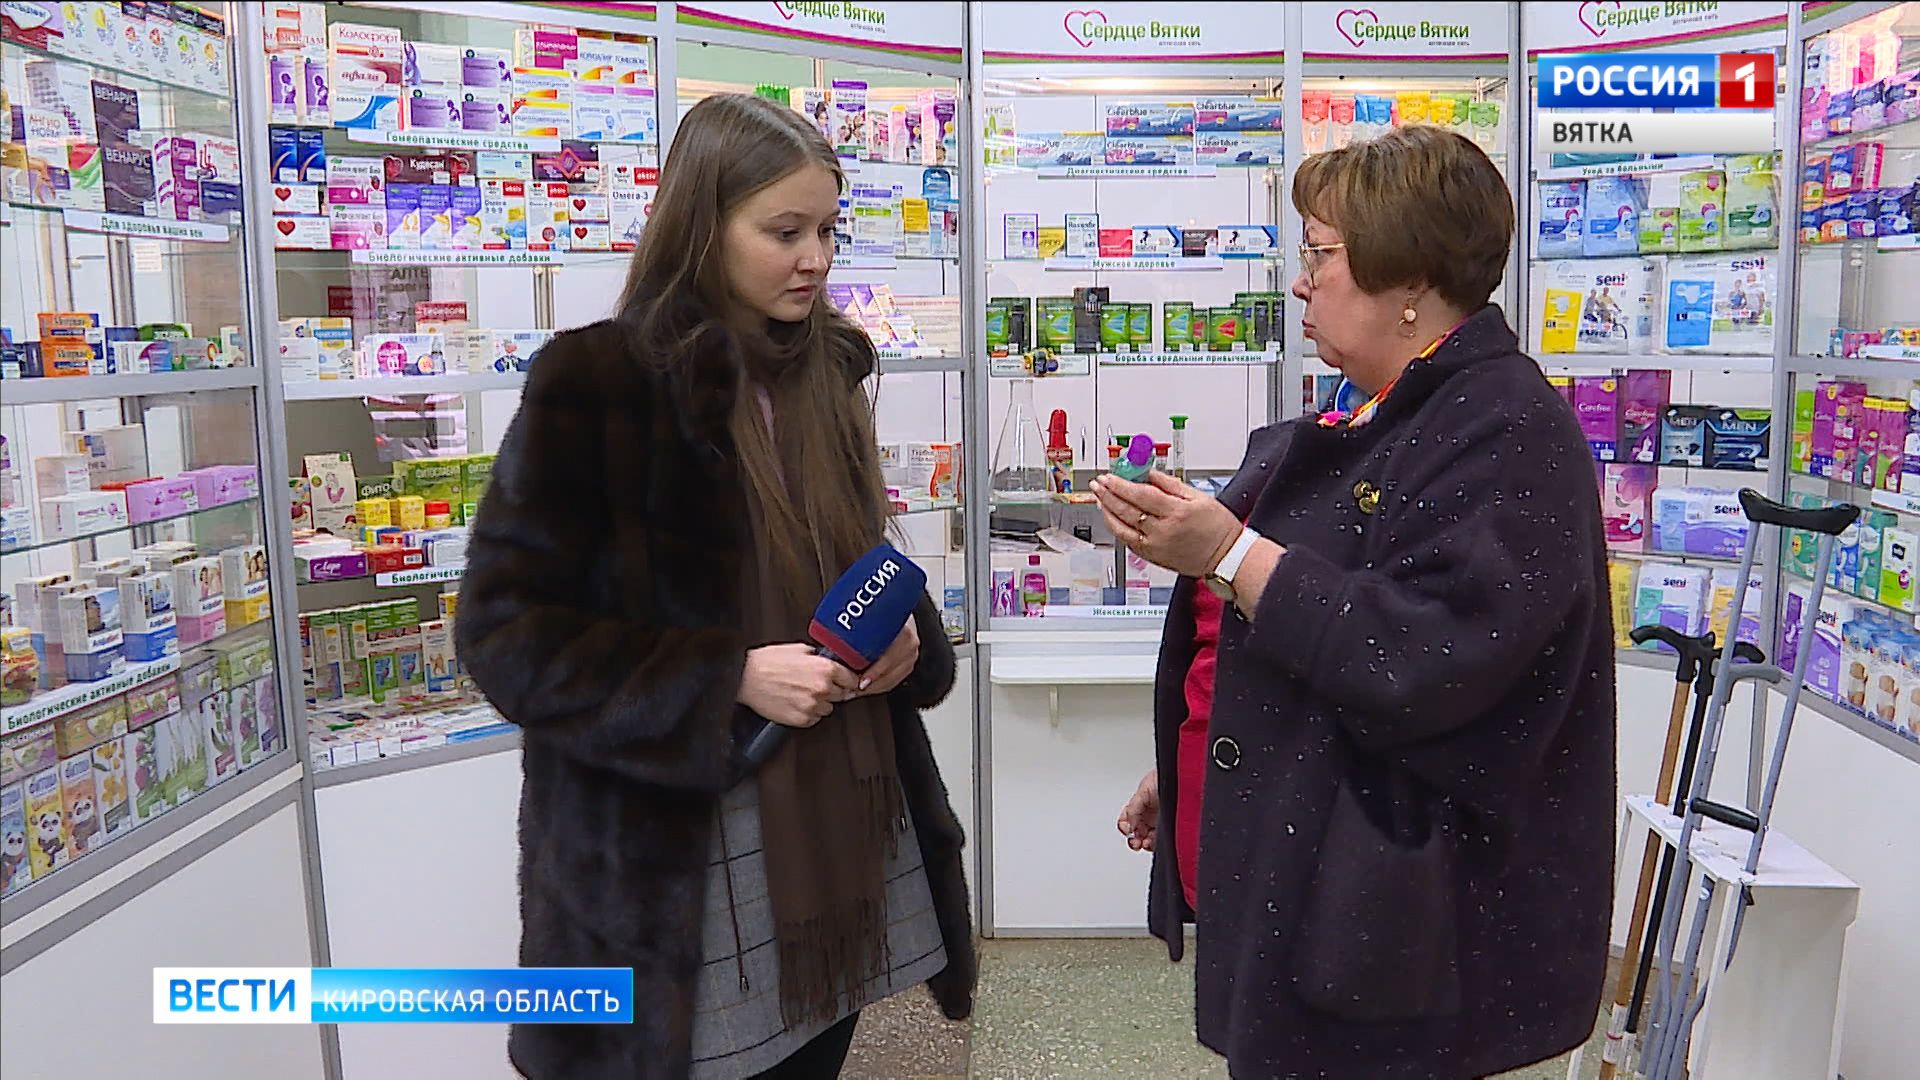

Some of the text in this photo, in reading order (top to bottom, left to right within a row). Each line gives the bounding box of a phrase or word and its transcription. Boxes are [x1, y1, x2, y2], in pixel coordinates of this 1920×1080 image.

[843, 3, 885, 25] Вятки
[1596, 4, 1660, 28] Сердце
[339, 27, 399, 44] Колофорт
[1083, 20, 1200, 41] Сердце Вятки
[1354, 20, 1469, 41] Сердце Вятки
[1106, 105, 1148, 117] Clearblue
[1196, 100, 1236, 111] Clearblue
[386, 132, 529, 150] Гомеопатические средства
[1106, 138, 1144, 149] Clearblue
[1198, 137, 1239, 147] Clearblue
[1066, 167, 1189, 177] Диагностические средства
[1582, 166, 1603, 176] Уход
[1617, 162, 1664, 172] больными
[101, 217, 204, 238] Для здоровья ваших вен
[368, 251, 551, 264] Биологические активные добавки
[1092, 260, 1176, 270] Мужское здоровье
[1115, 353, 1147, 363] Борьба
[1157, 355, 1204, 363] вредными
[1206, 355, 1262, 364] привычками
[1578, 402, 1612, 412] Carefree
[1669, 416, 1697, 427] MEN
[1722, 420, 1757, 431] MEN
[837, 559, 901, 630] РОССИЯ
[1092, 607, 1132, 617] Женская
[7, 662, 171, 731] Биологические активные добавки
